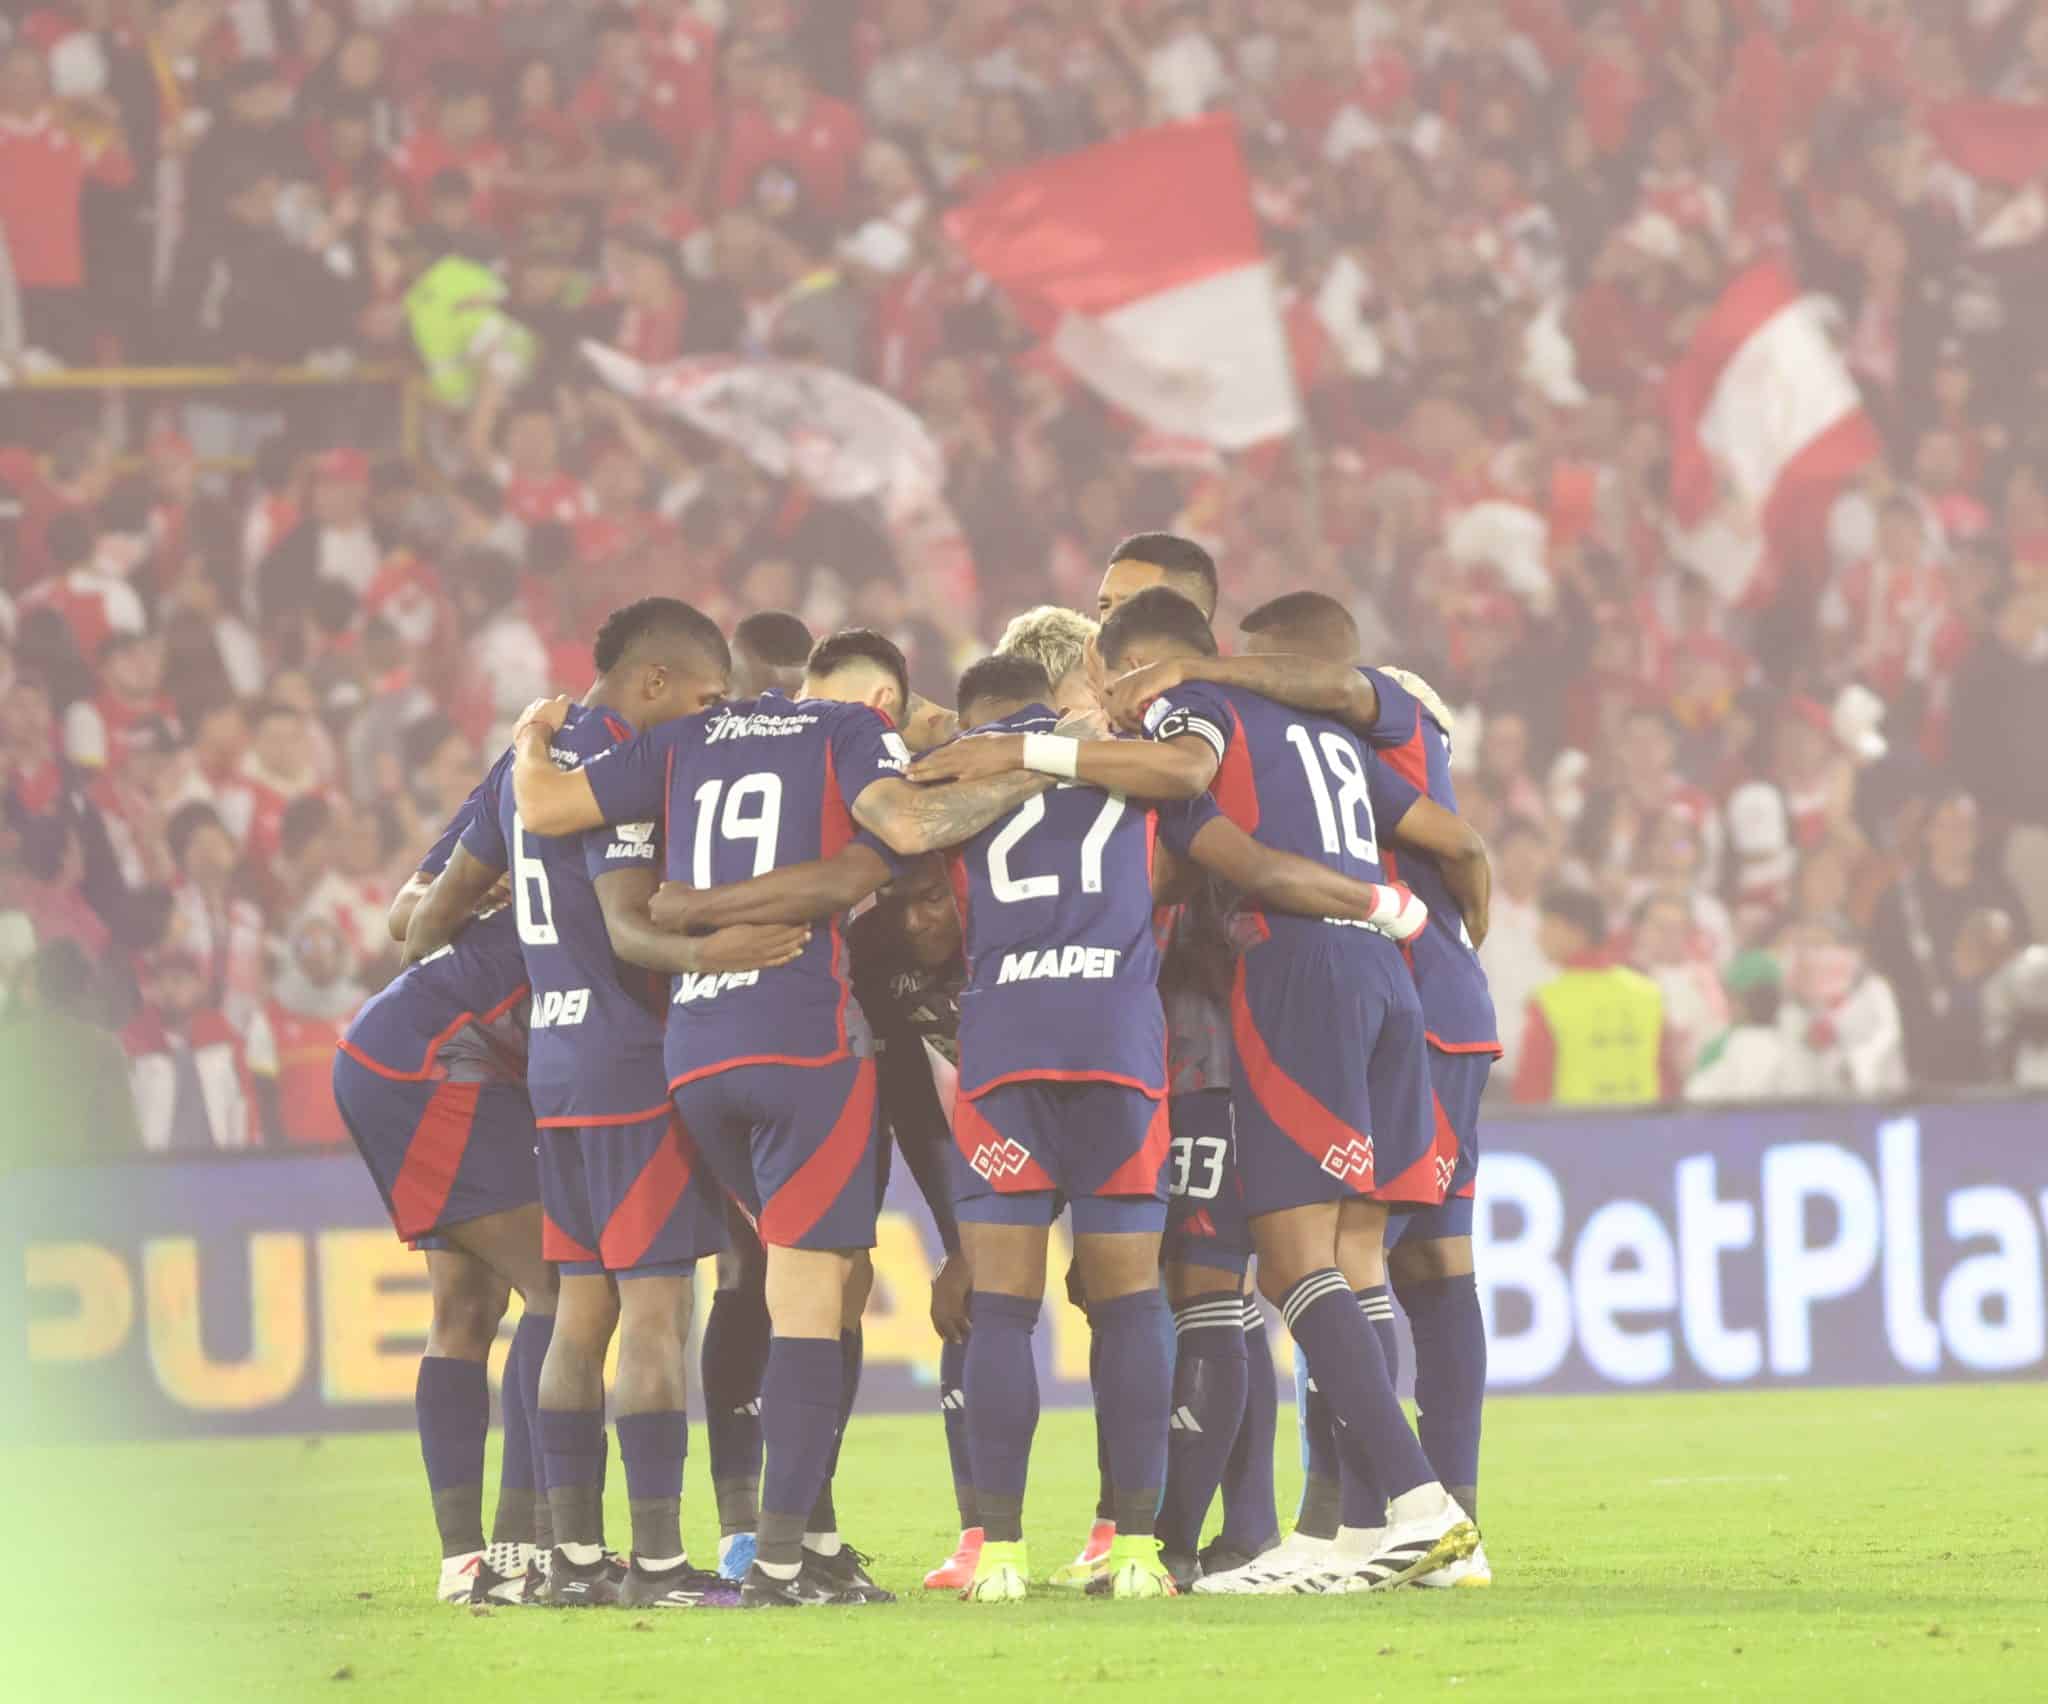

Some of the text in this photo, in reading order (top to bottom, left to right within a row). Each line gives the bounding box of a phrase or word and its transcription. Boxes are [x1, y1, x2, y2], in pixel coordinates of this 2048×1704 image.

[604, 843, 655, 859] MAPEI
[693, 772, 783, 889] 19
[988, 783, 1126, 903] 27
[1286, 724, 1379, 865] 18
[513, 811, 559, 945] 6
[997, 945, 1121, 985] MAPEI
[1169, 1136, 1227, 1199] 33
[1473, 1117, 2048, 1388] BetPla
